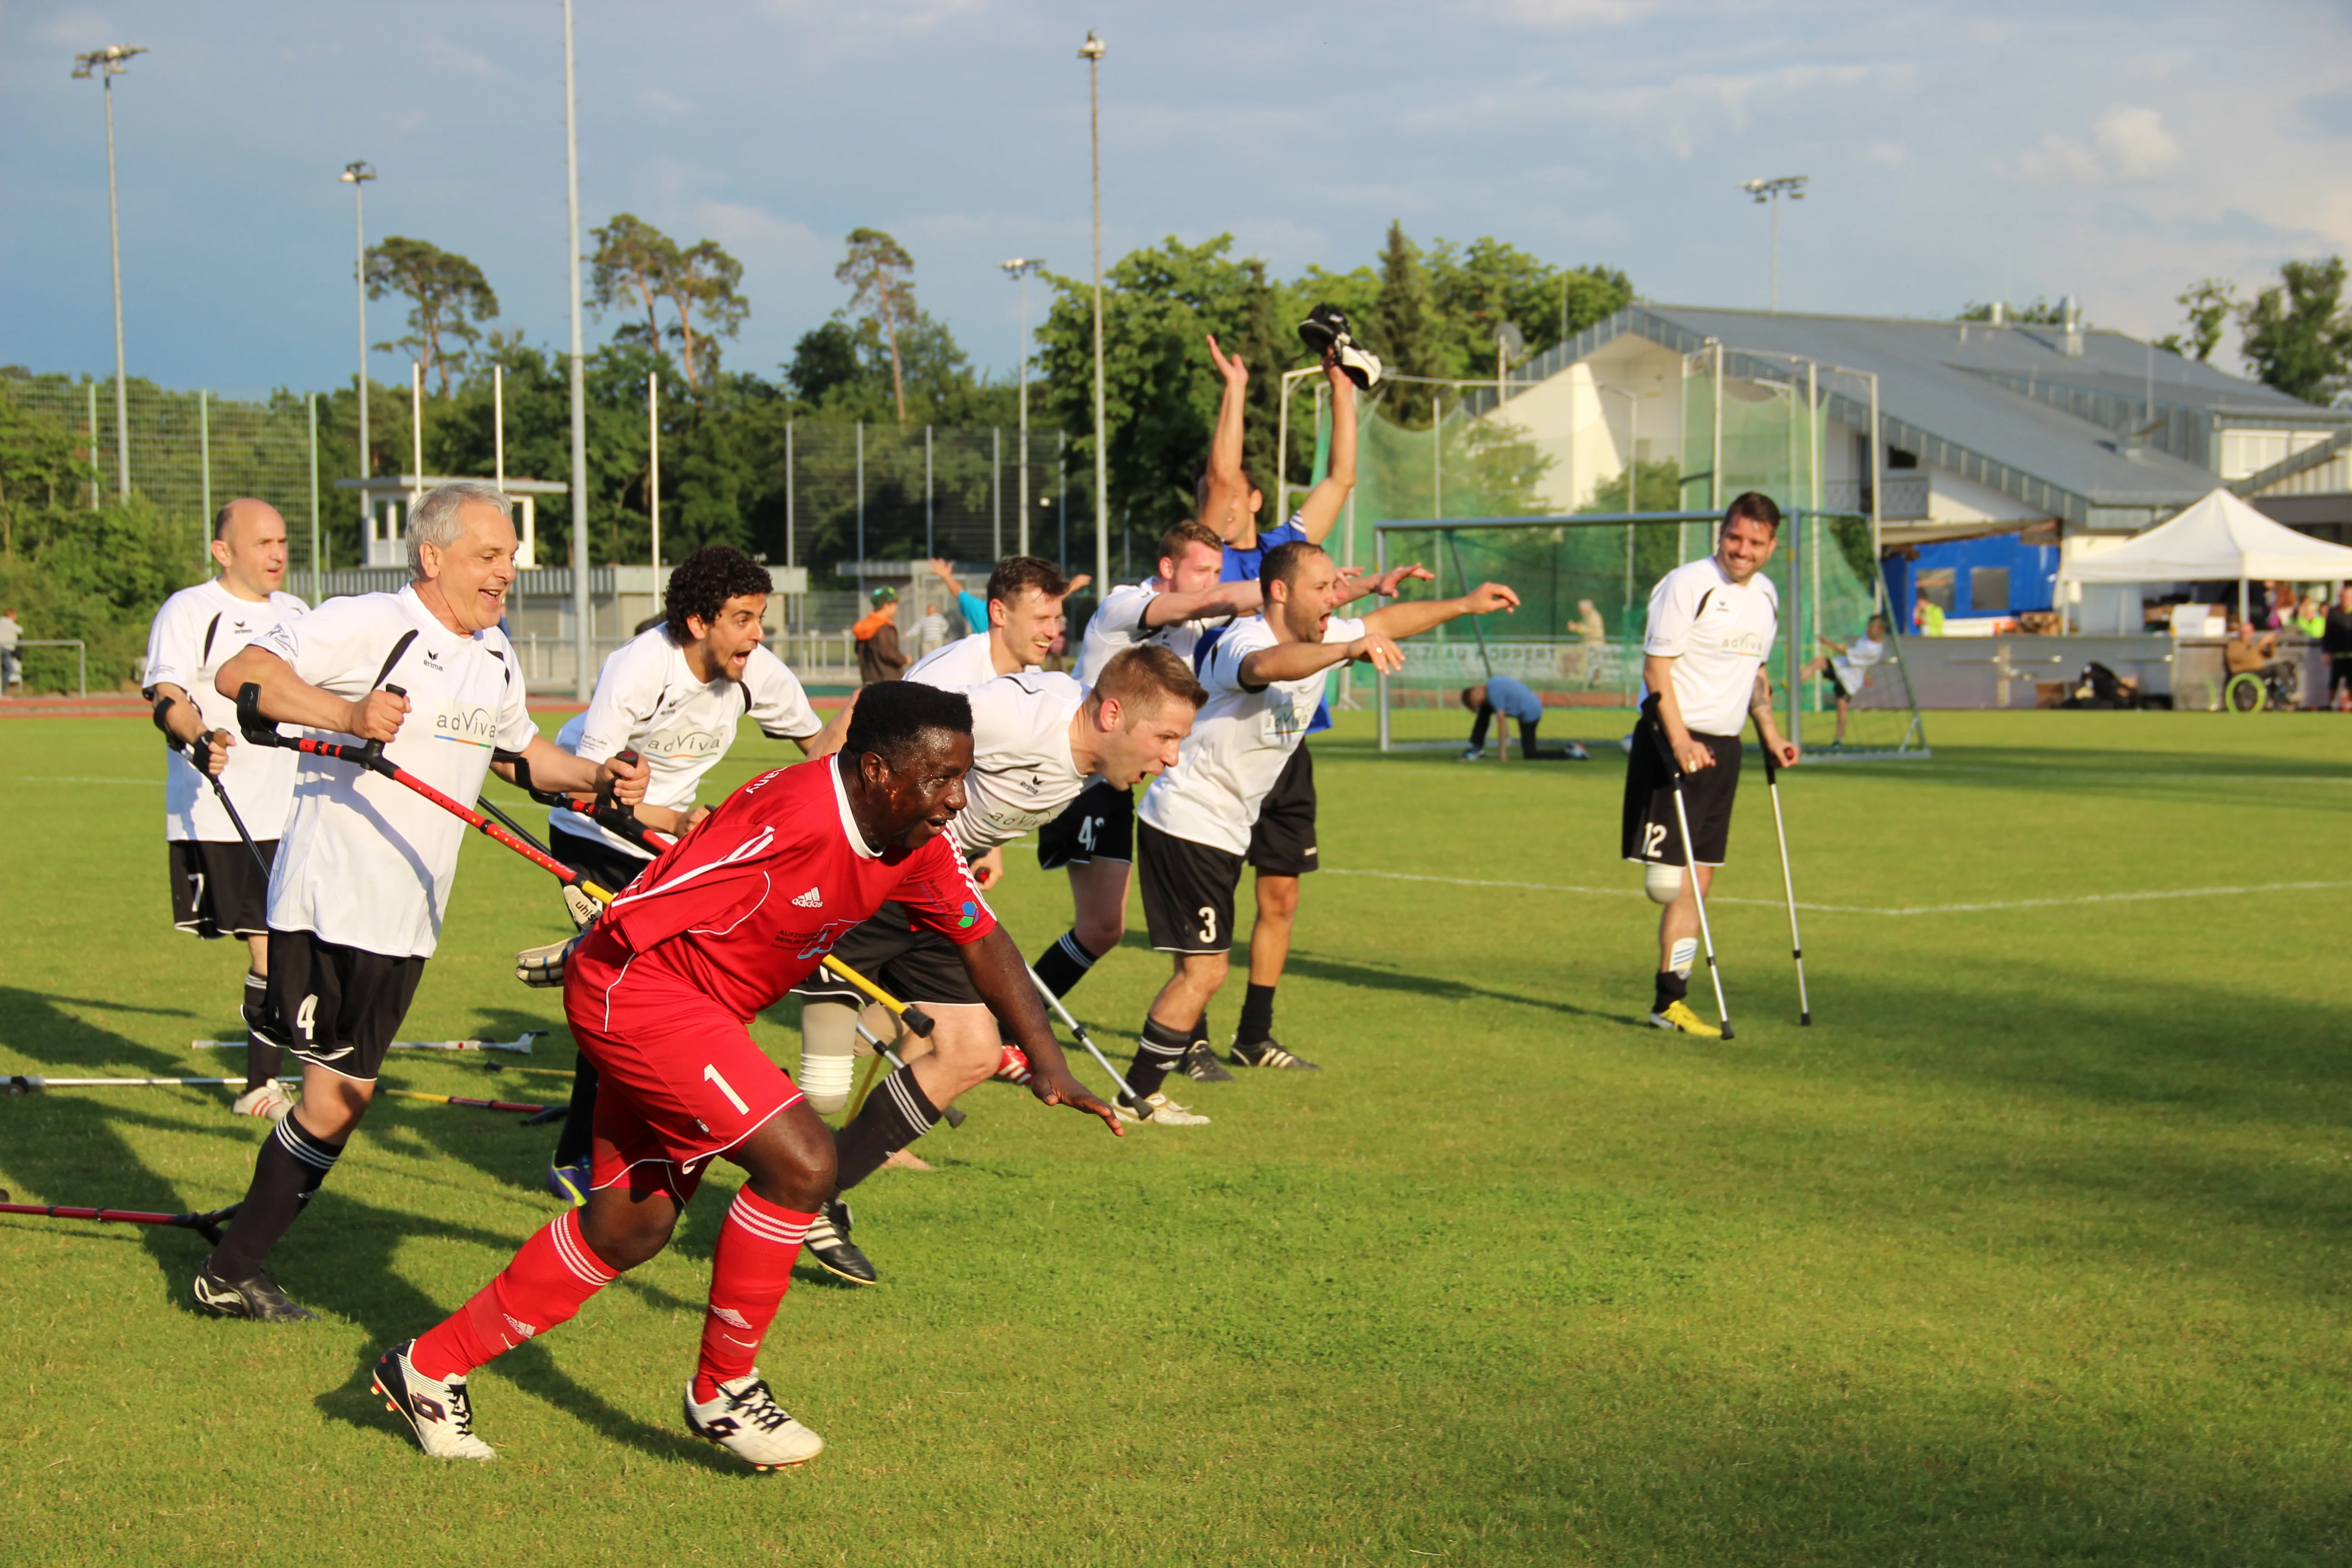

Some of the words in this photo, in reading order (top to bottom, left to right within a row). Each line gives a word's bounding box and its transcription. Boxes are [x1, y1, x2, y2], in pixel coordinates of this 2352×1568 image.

[423, 659, 443, 672] erima
[436, 708, 496, 739] adViva
[648, 731, 720, 753] adViva
[1019, 781, 1039, 794] erima
[1641, 822, 1667, 858] 12
[188, 873, 205, 912] 7
[792, 898, 823, 908] adidas
[1198, 906, 1216, 943] 3
[296, 994, 318, 1040] 4
[704, 1063, 750, 1116] 1
